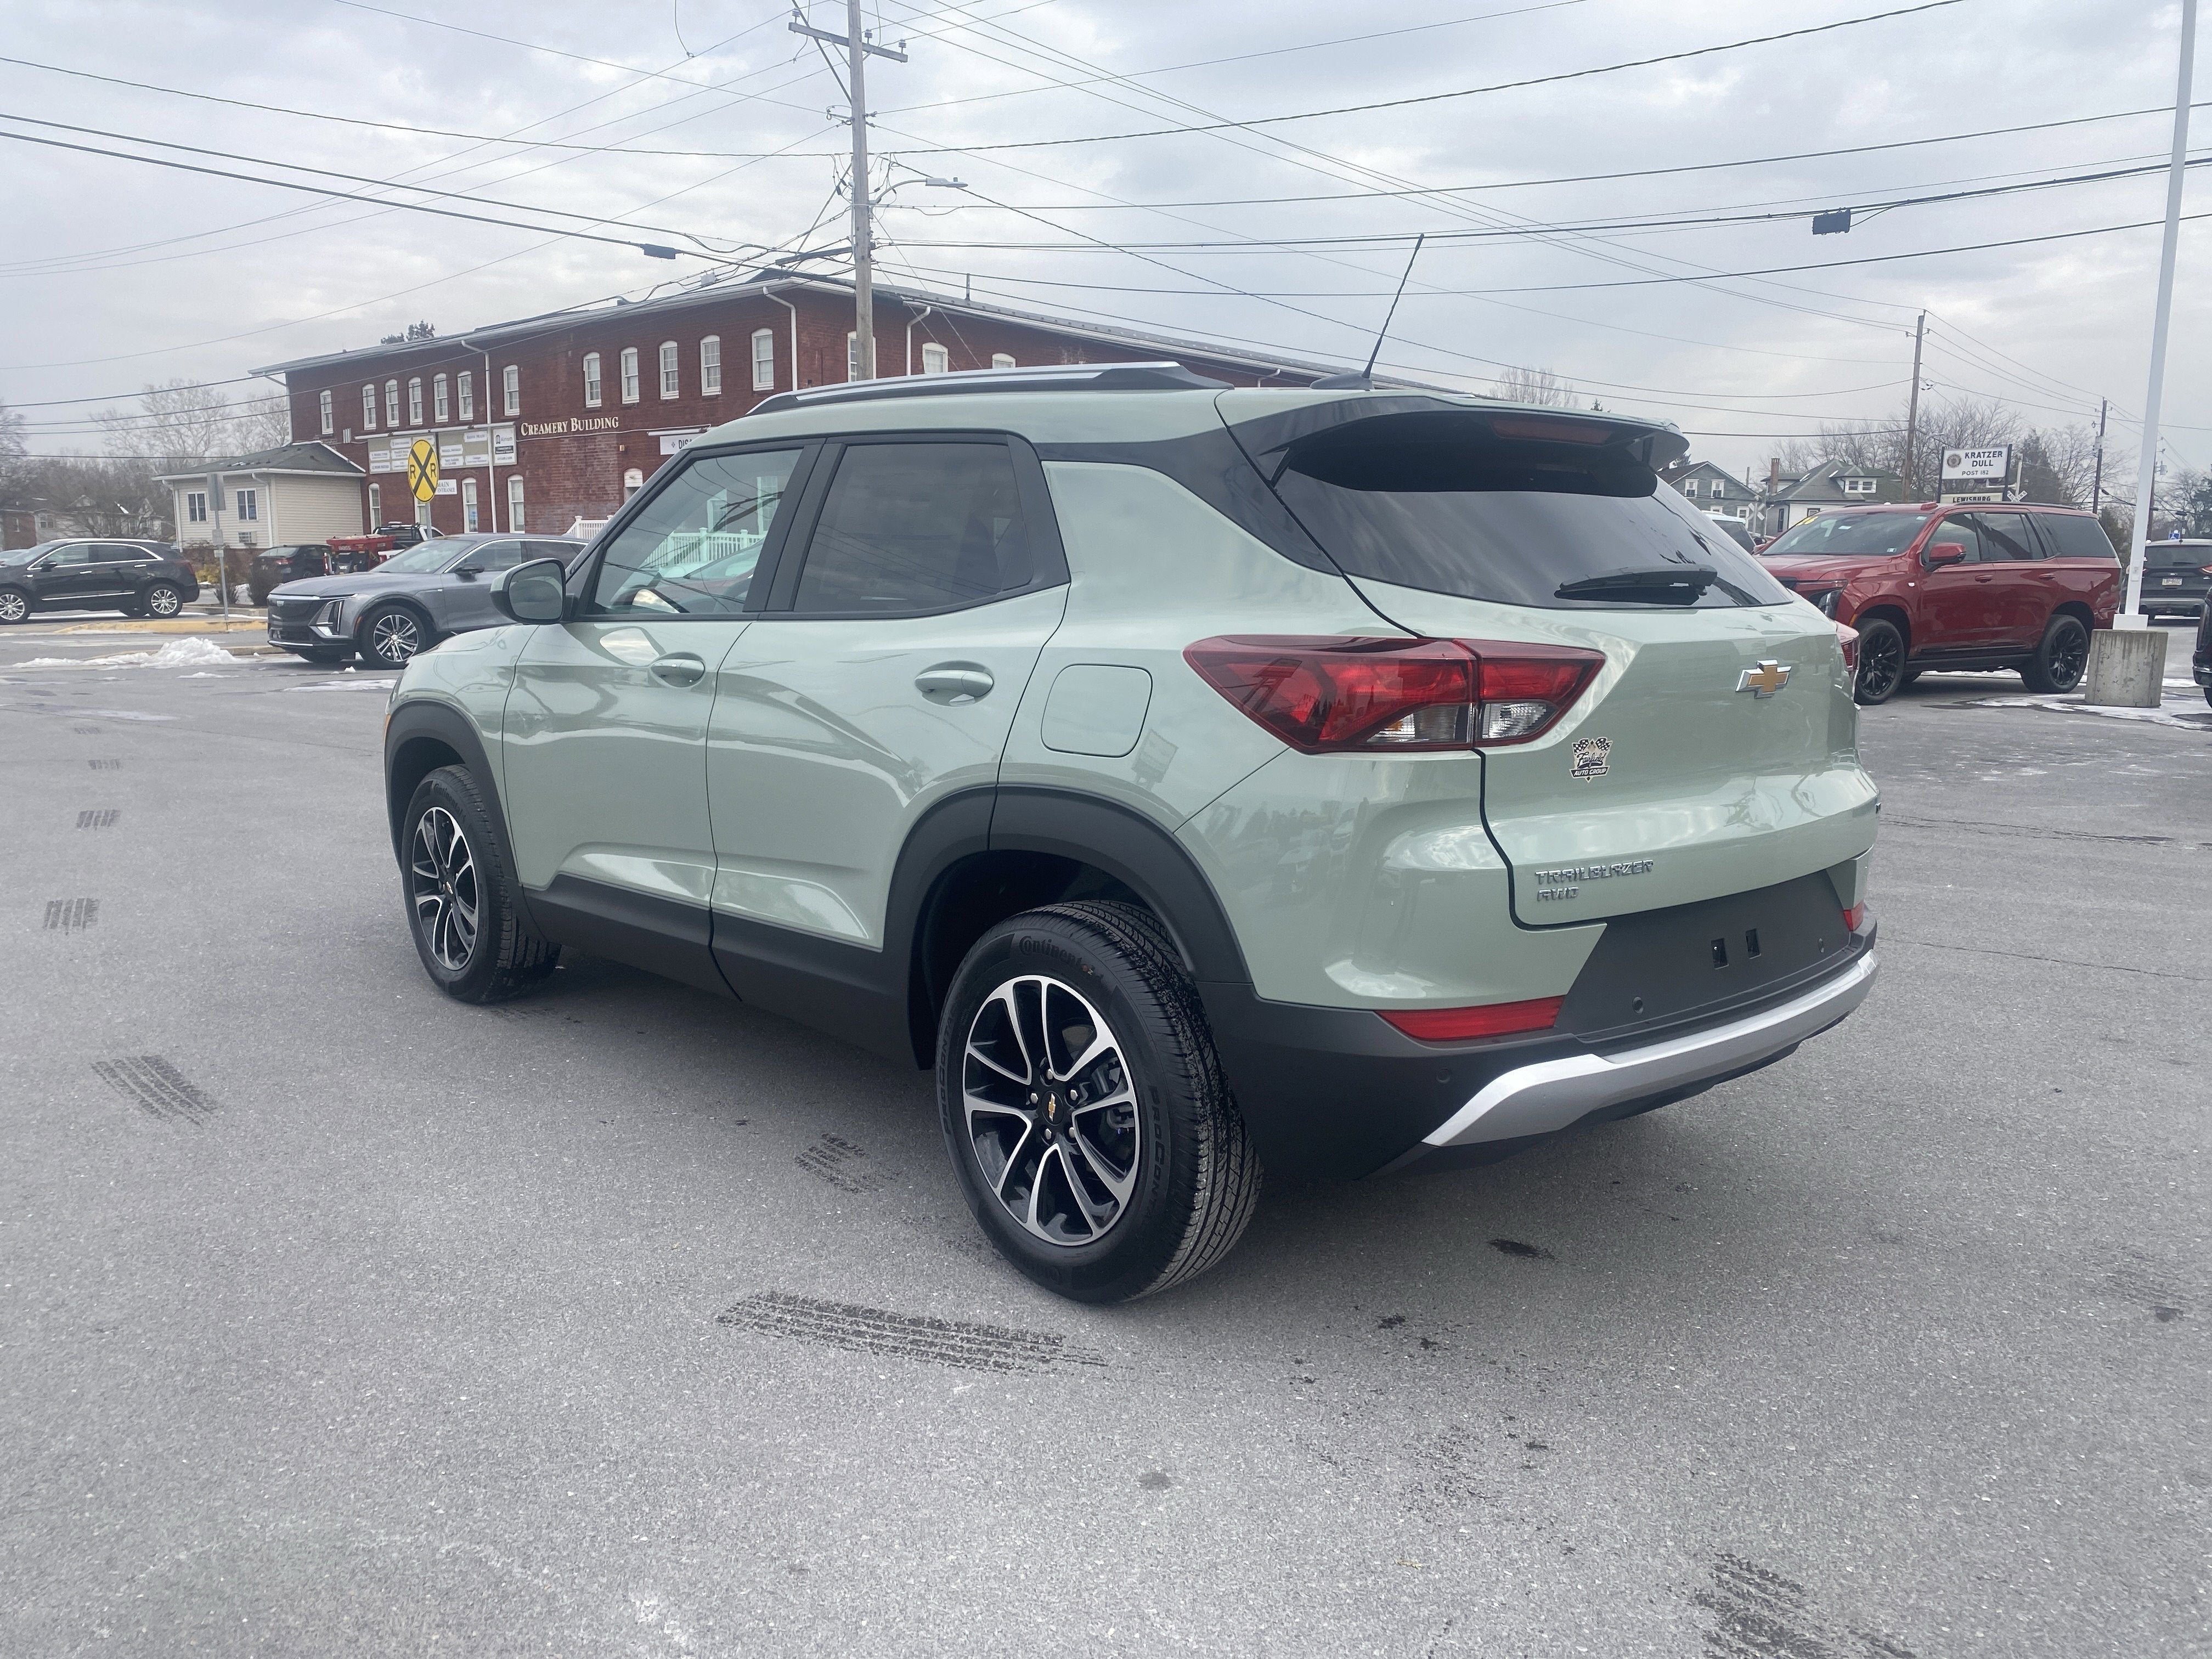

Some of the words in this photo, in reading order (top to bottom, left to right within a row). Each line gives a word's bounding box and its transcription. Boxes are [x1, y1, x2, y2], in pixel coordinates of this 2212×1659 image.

[521, 421, 568, 436] CREAMERY
[571, 417, 619, 432] BUILDING
[1965, 450, 2003, 459] KRATZER
[410, 465, 416, 479] R
[430, 463, 436, 477] R
[1535, 860, 1654, 885] TRAILBLAZER
[1019, 935, 1096, 975] Continent
